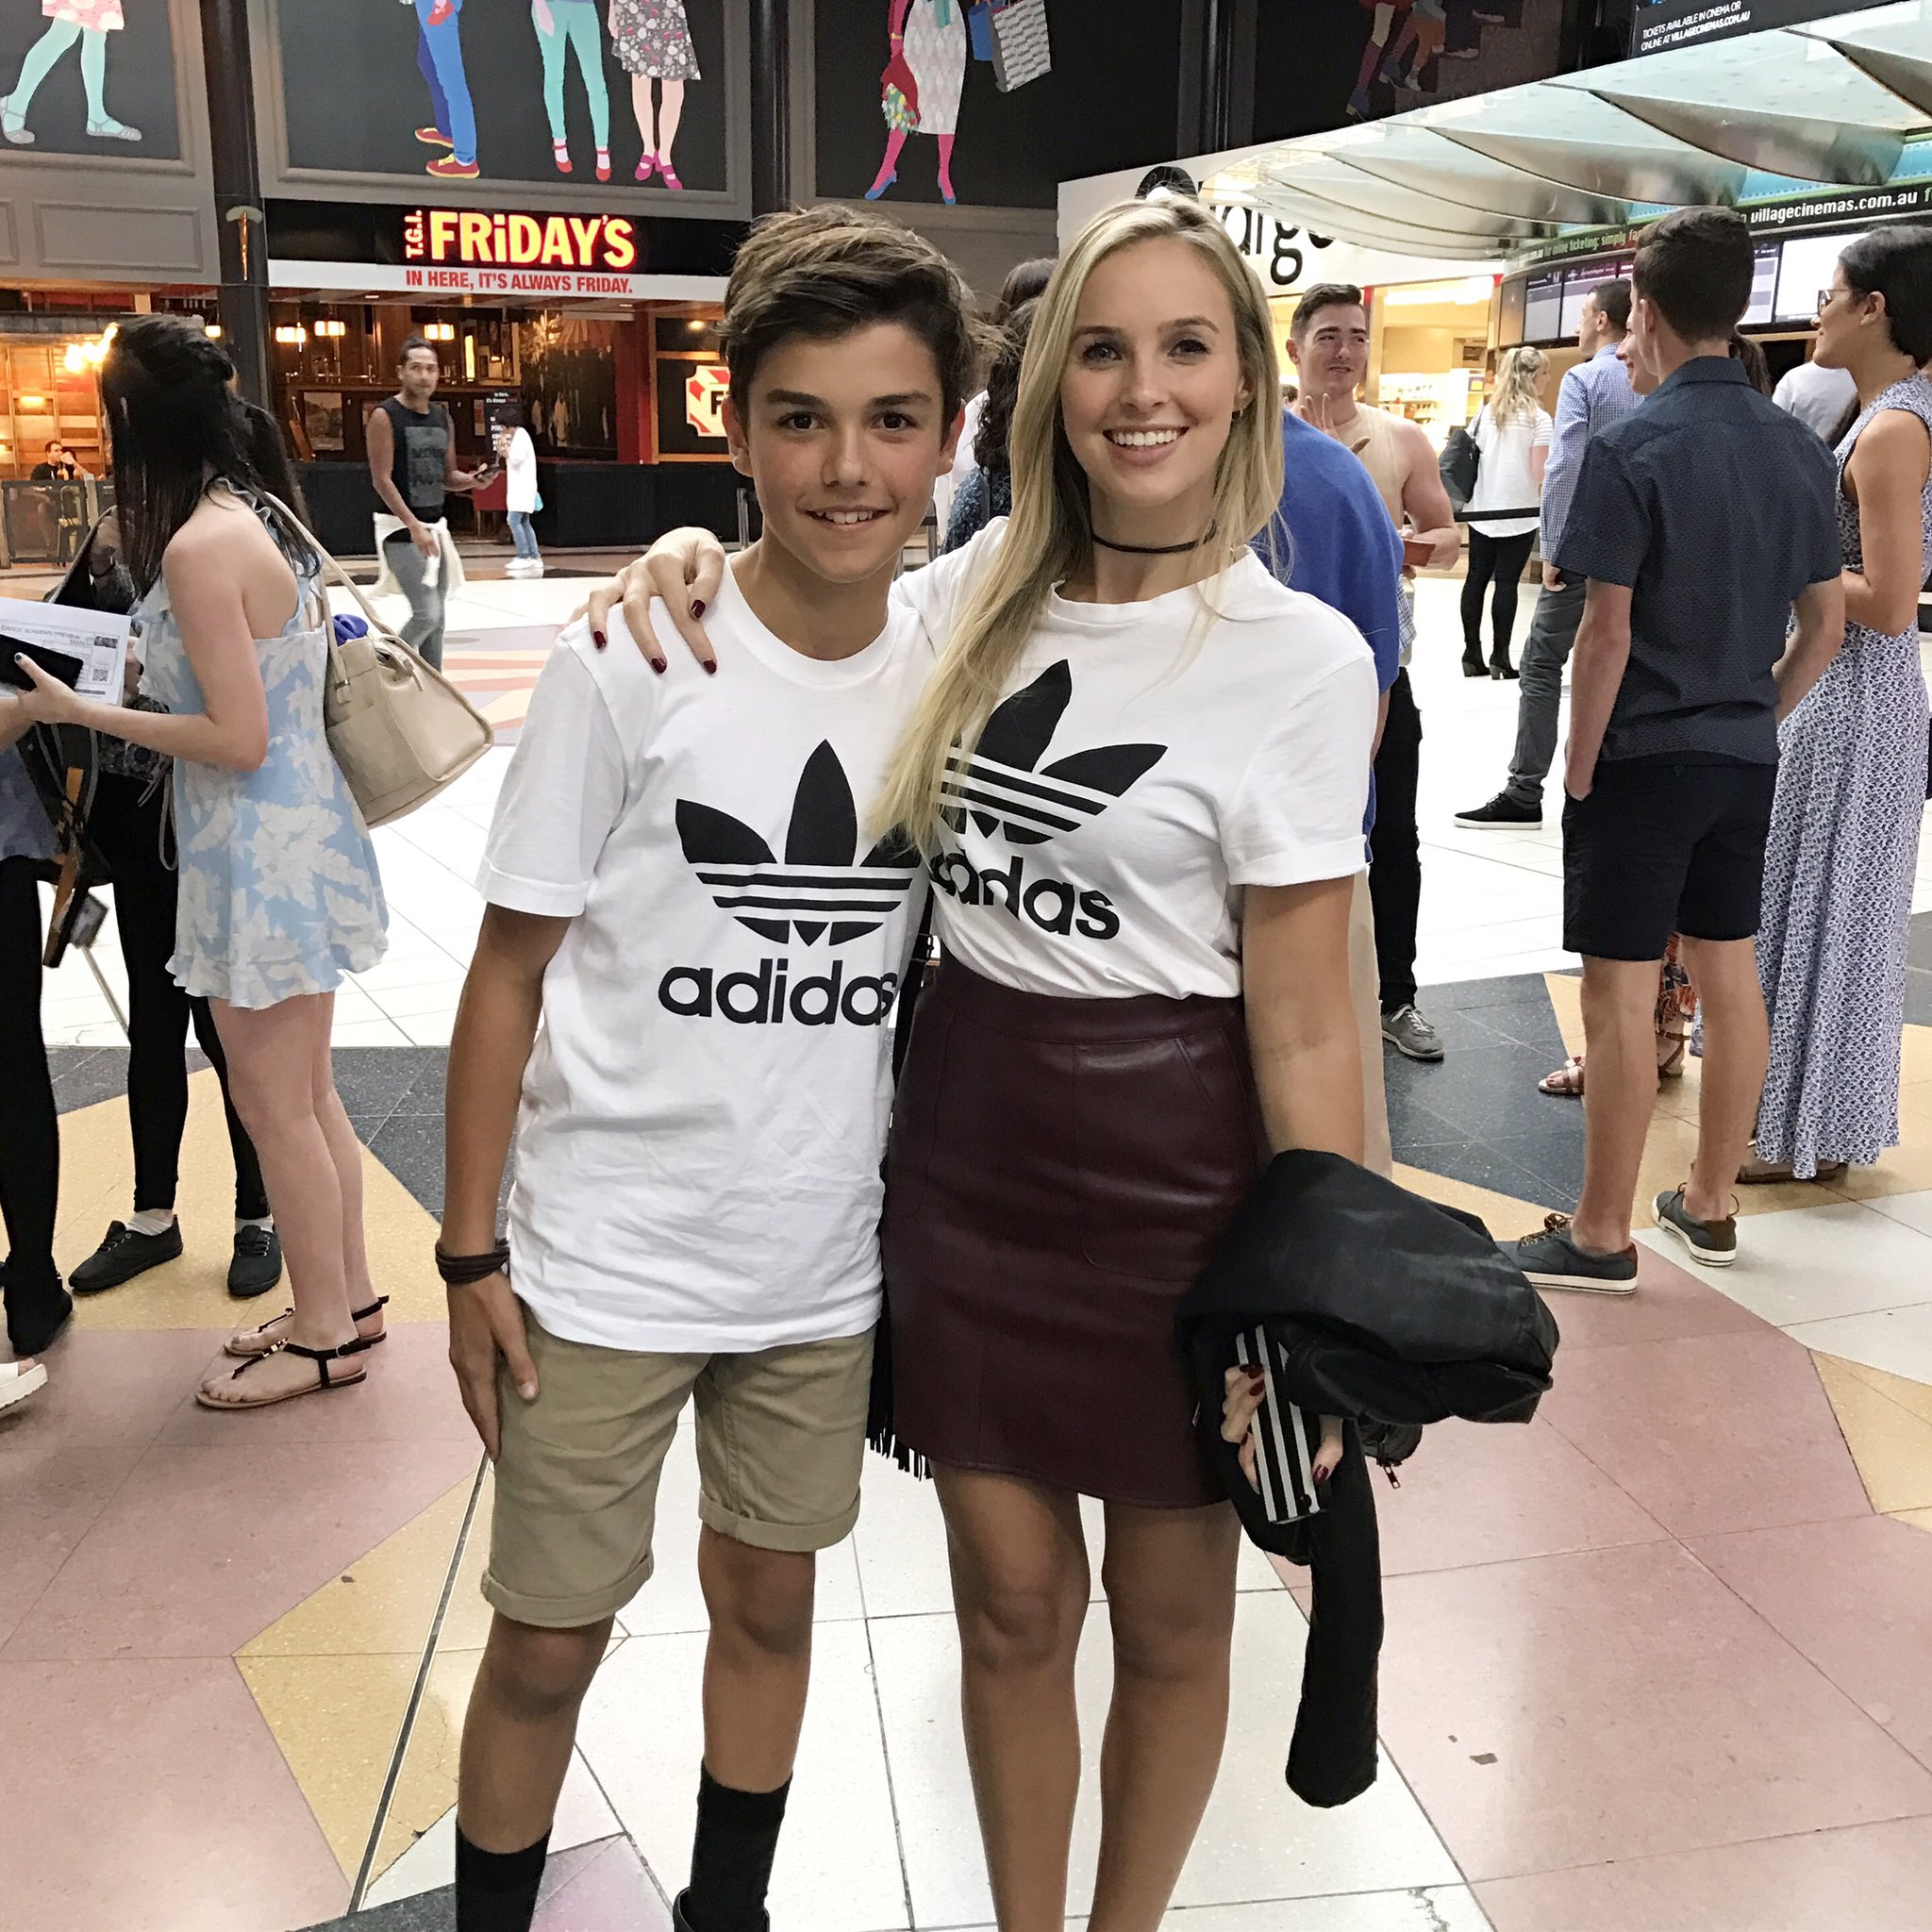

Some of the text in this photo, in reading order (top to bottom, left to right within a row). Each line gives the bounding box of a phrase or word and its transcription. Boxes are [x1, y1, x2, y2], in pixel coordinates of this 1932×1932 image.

[1641, 9, 1751, 51] ONLINE AT VILLAGECINEMAS.COM.AU
[1642, 0, 1741, 40] TICKETS AVAILABLE IN CINEMA OR
[1750, 191, 1919, 225] villagecinemas.com.au
[404, 208, 425, 259] T.G.I.
[405, 269, 634, 294] IN HERE, IT'S ALWAYS FRIDAY.
[658, 958, 898, 1027] adidas
